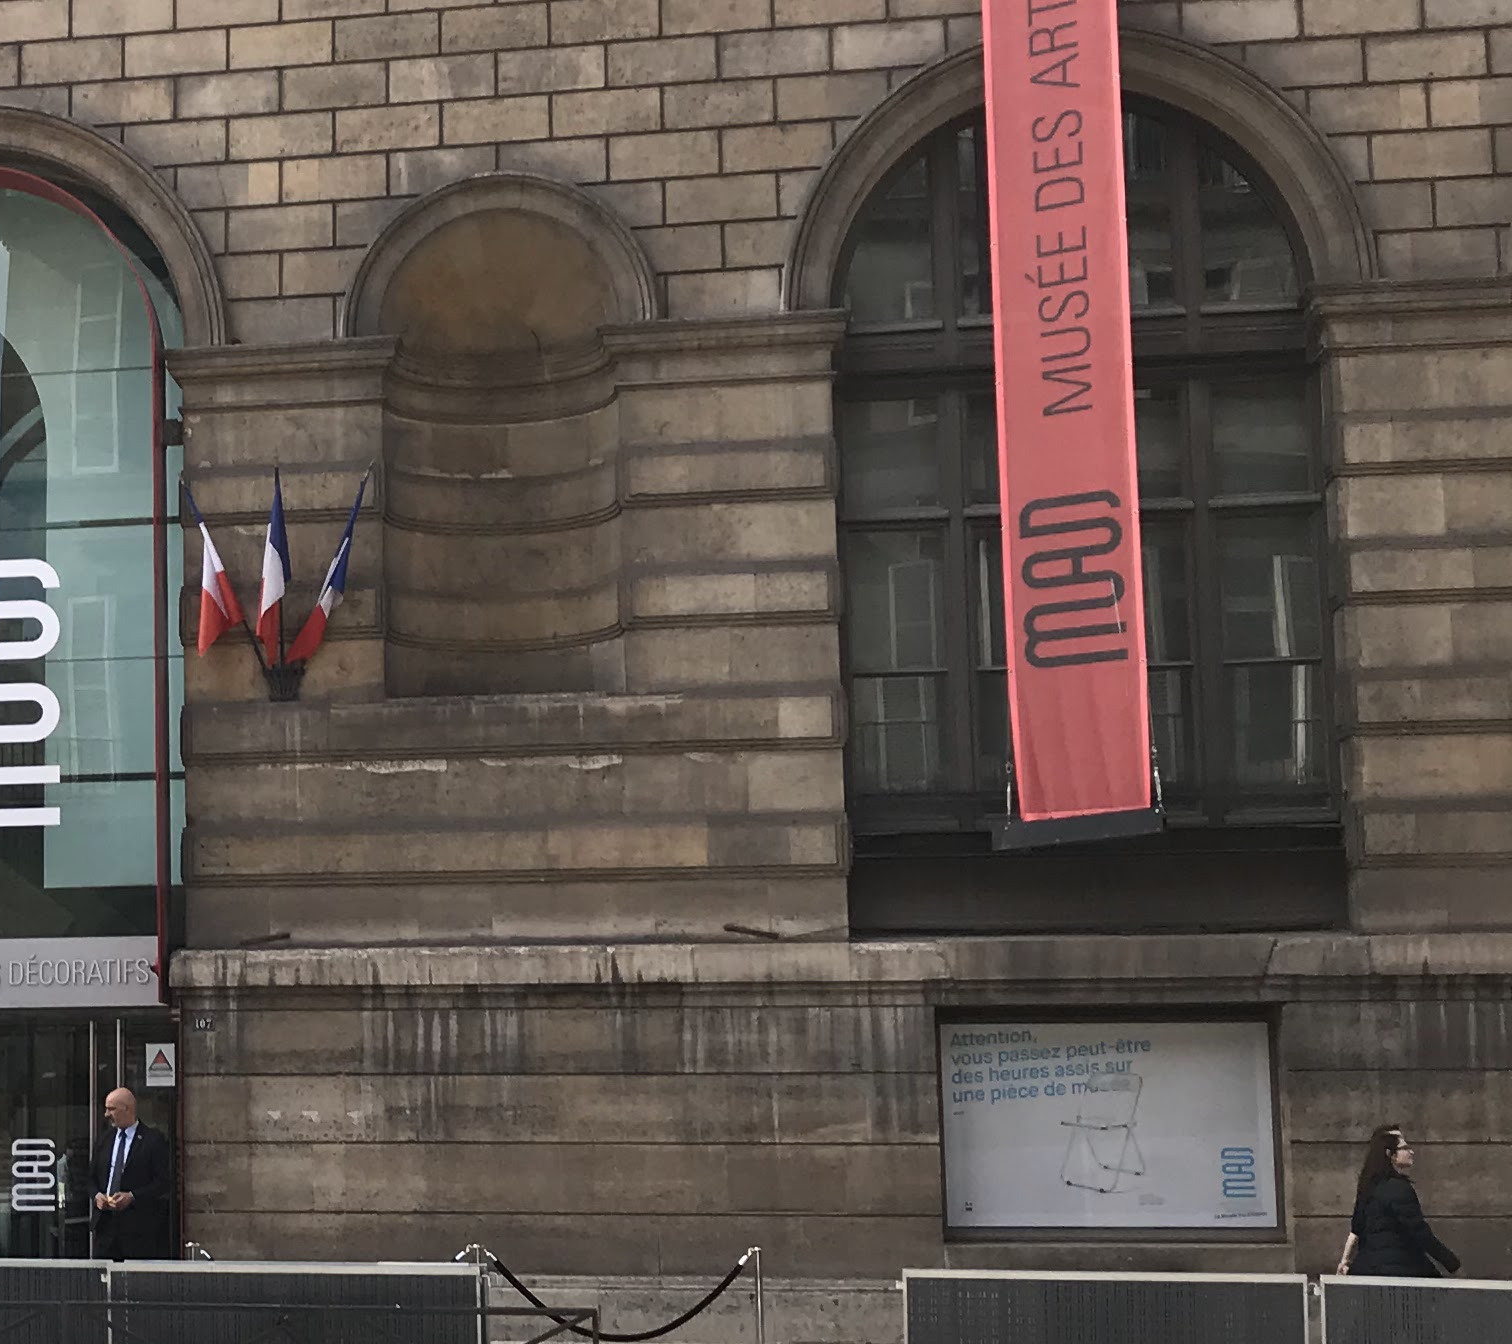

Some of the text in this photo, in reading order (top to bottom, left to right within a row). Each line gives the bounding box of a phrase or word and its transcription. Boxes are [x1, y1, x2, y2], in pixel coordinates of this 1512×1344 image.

[1031, 108, 1085, 212] DES
[1024, 225, 1094, 417] MUSÉE
[1019, 488, 1129, 669] MAD
[8, 954, 150, 986] DÉCORATIFS
[195, 1018, 212, 1029] 107
[950, 1030, 1037, 1047] Attention,
[951, 1038, 1152, 1066] vous passez peut-être
[951, 1059, 1133, 1084] des heures assis sur
[952, 1087, 985, 1104] une
[990, 1084, 1039, 1105] pièce
[1044, 1081, 1067, 1096] de
[11, 1138, 56, 1212] MAD
[1220, 1146, 1257, 1198] MAD
